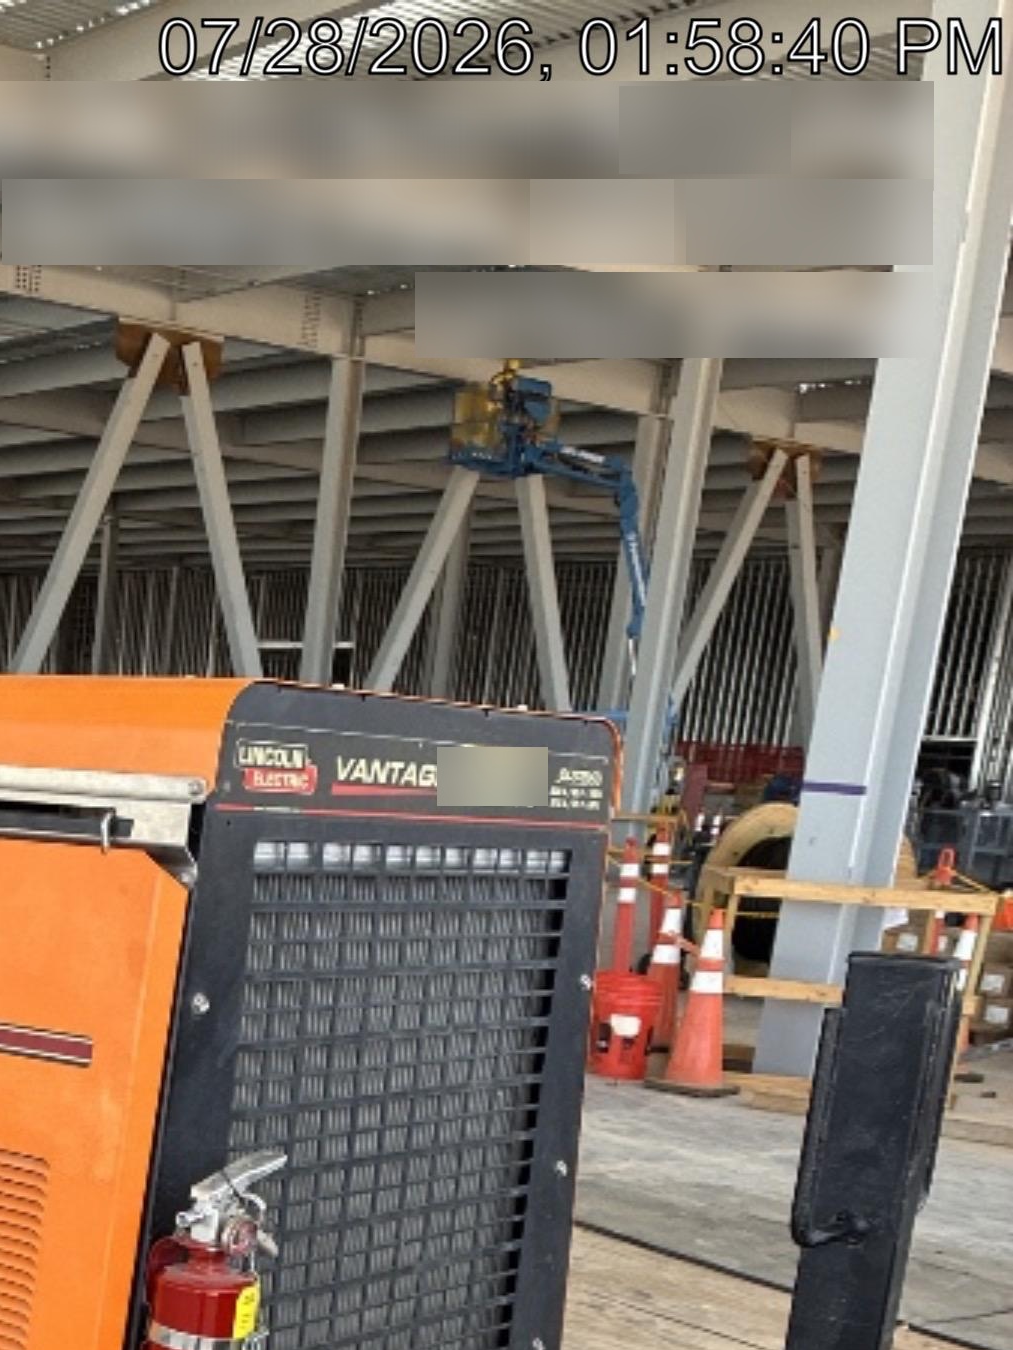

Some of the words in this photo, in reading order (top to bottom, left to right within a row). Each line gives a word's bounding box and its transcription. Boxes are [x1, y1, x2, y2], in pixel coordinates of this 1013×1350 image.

[239, 746, 304, 769] LINCOLN
[252, 769, 309, 789] ELECTRIC
[336, 755, 438, 788] VANTAG
